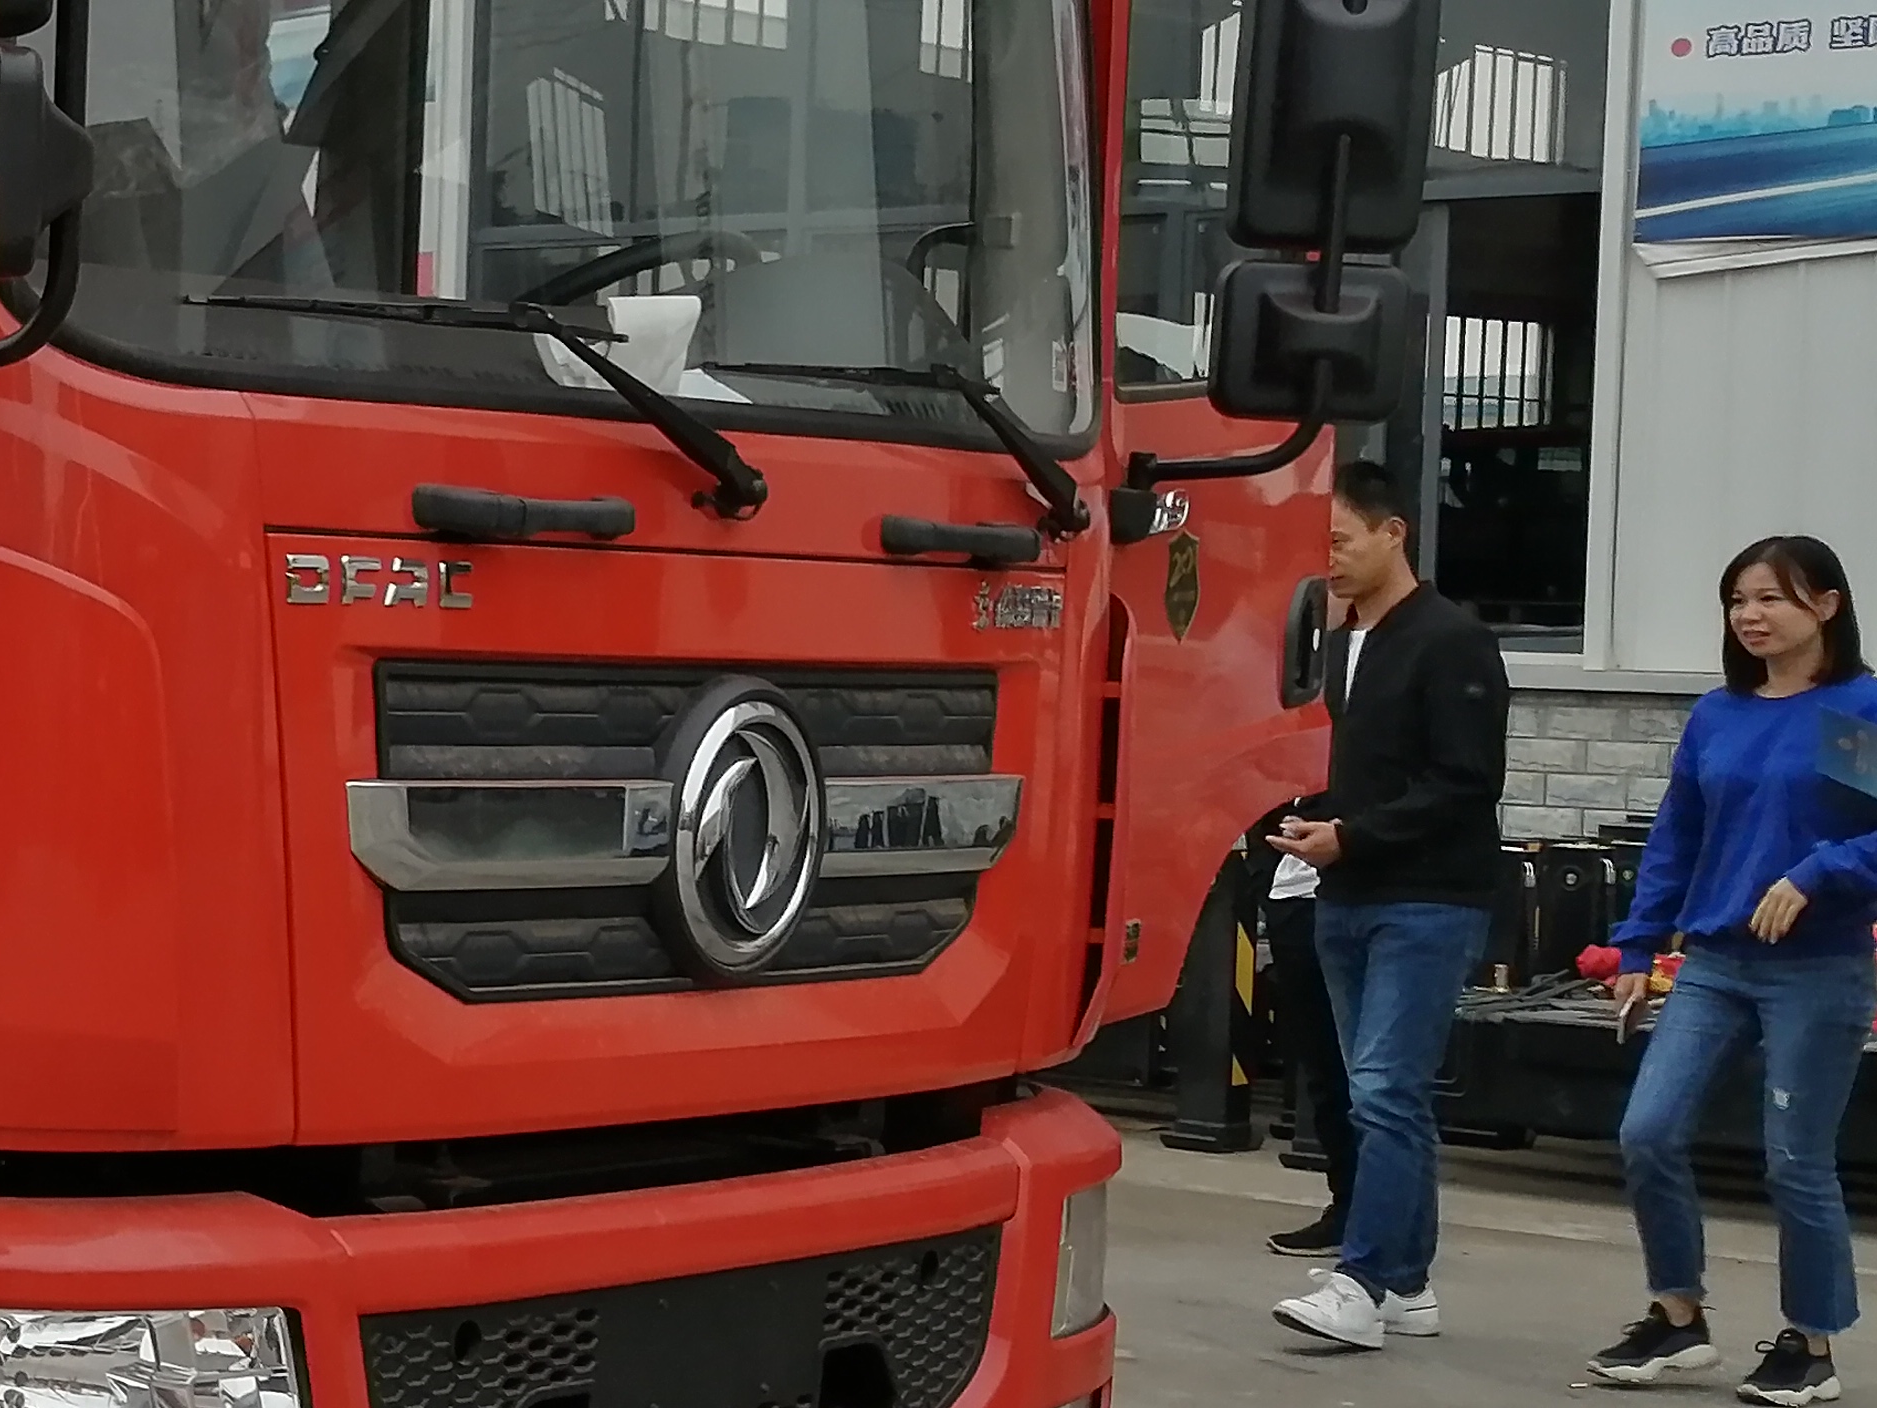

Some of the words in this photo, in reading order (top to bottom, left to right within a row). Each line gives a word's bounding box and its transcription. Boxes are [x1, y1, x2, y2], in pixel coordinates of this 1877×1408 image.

[1706, 19, 1812, 59] 高品质
[1829, 14, 1877, 50] 坚
[285, 553, 474, 609] DFAC
